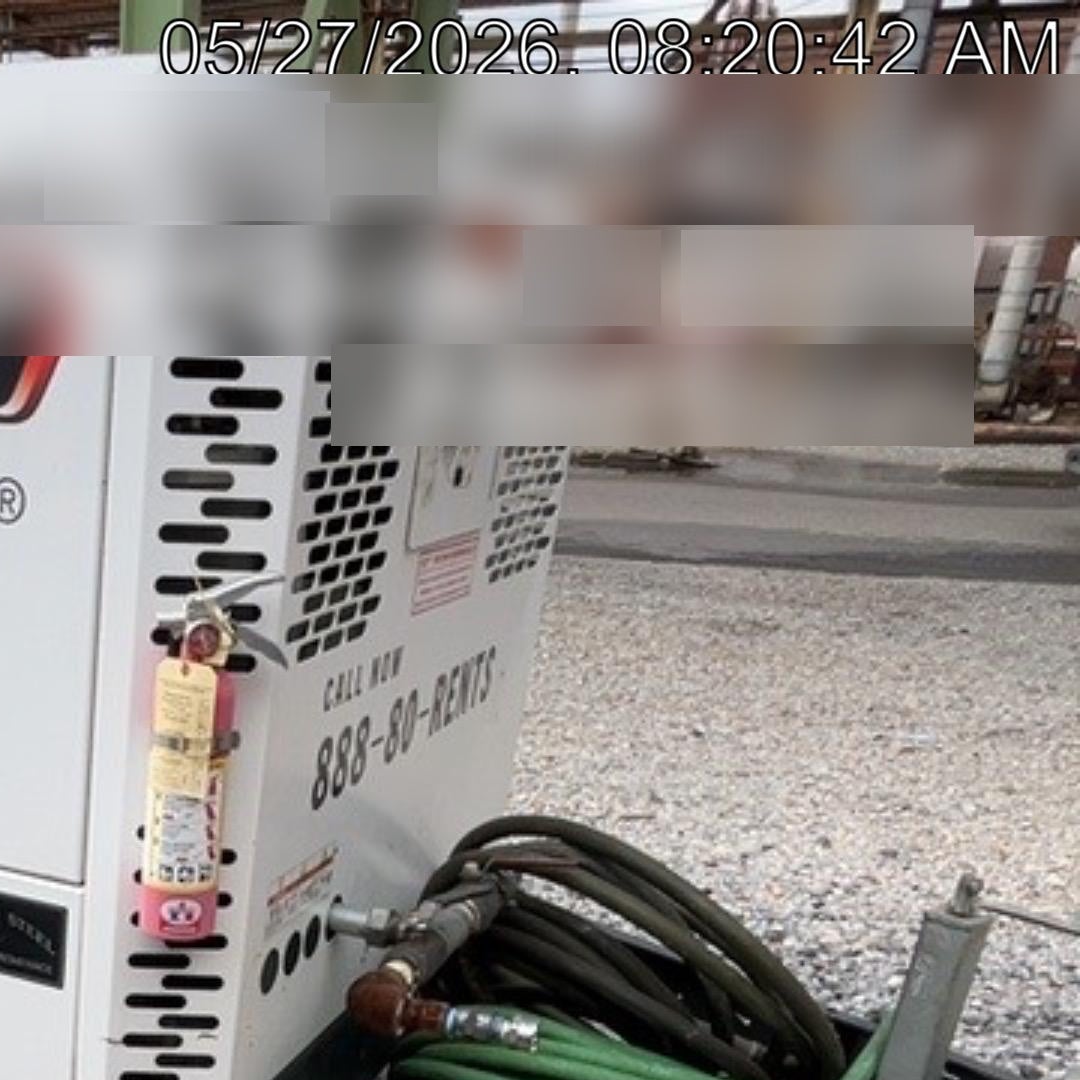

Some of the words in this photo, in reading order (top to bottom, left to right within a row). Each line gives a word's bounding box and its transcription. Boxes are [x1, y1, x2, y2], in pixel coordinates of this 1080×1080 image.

[311, 645, 496, 811] 888-80-RENTS
[323, 664, 363, 712] CALL
[369, 645, 406, 688] NOW
